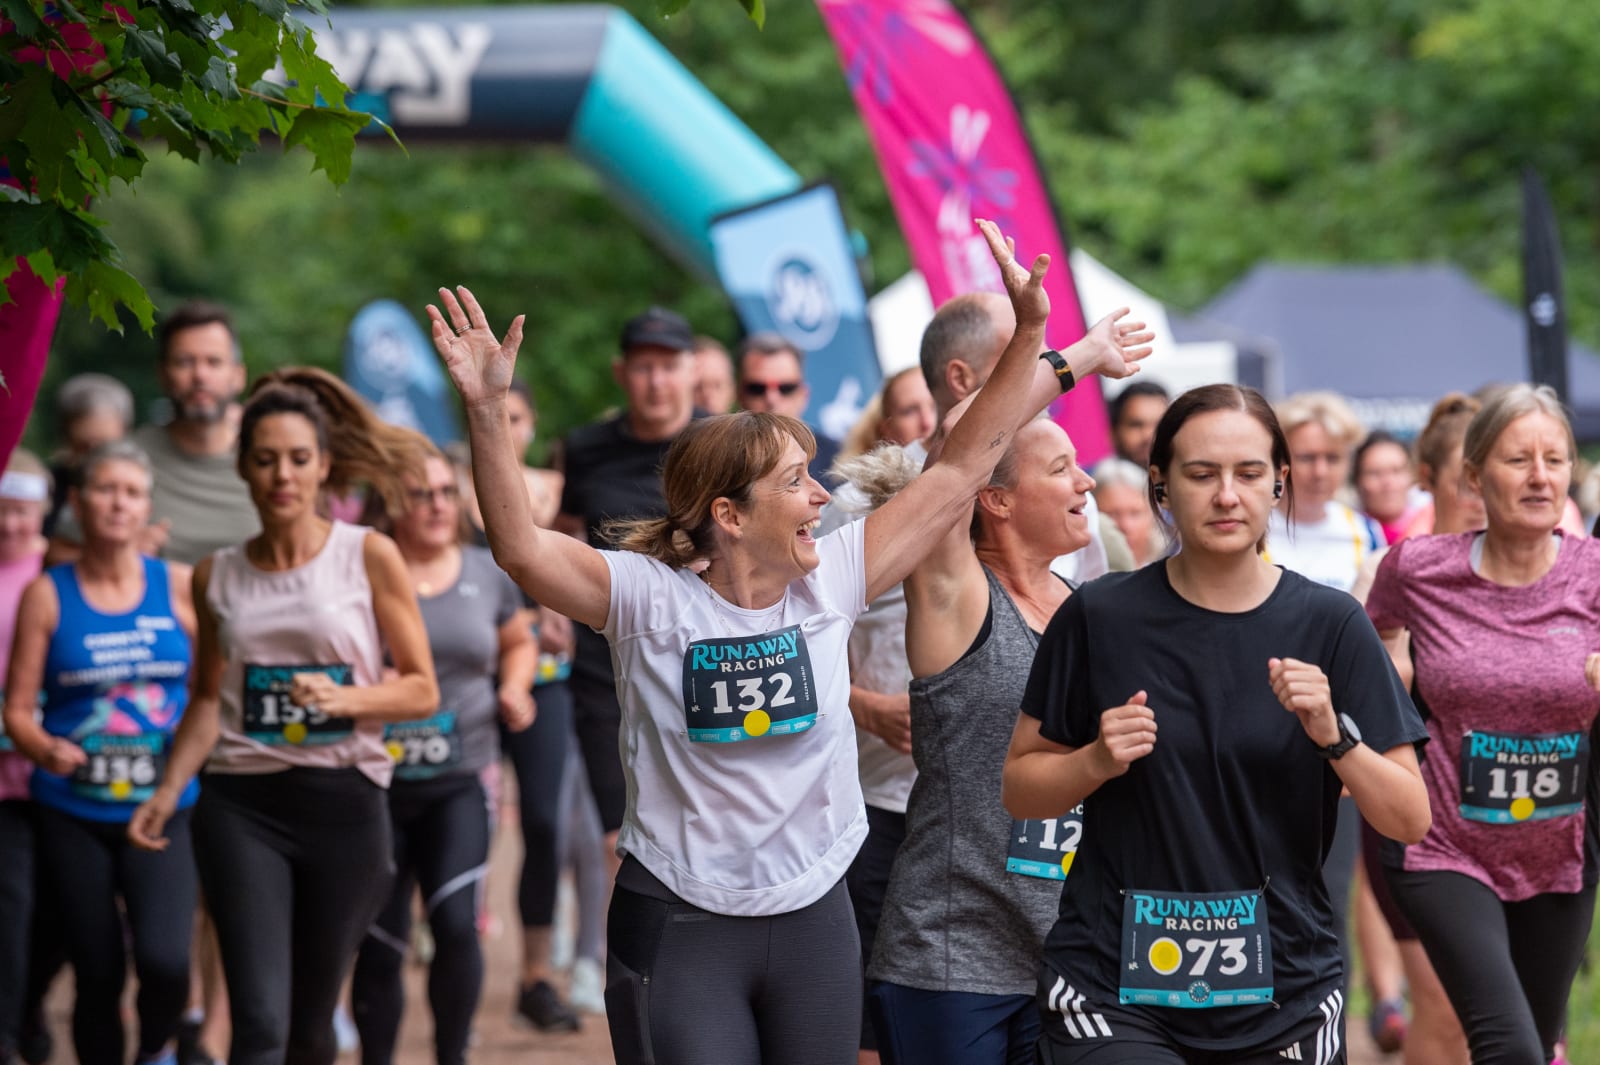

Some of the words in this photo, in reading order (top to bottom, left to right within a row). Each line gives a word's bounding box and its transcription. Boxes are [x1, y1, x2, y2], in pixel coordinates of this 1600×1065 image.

[692, 630, 798, 670] RUNAWAY
[720, 653, 785, 673] RACING
[710, 672, 796, 714] 132
[1471, 732, 1581, 759] RUNAWAY
[1496, 752, 1560, 765] RACING
[1488, 768, 1561, 799] 118
[1133, 894, 1258, 925] RUNAWAY
[1165, 917, 1238, 931] RACING
